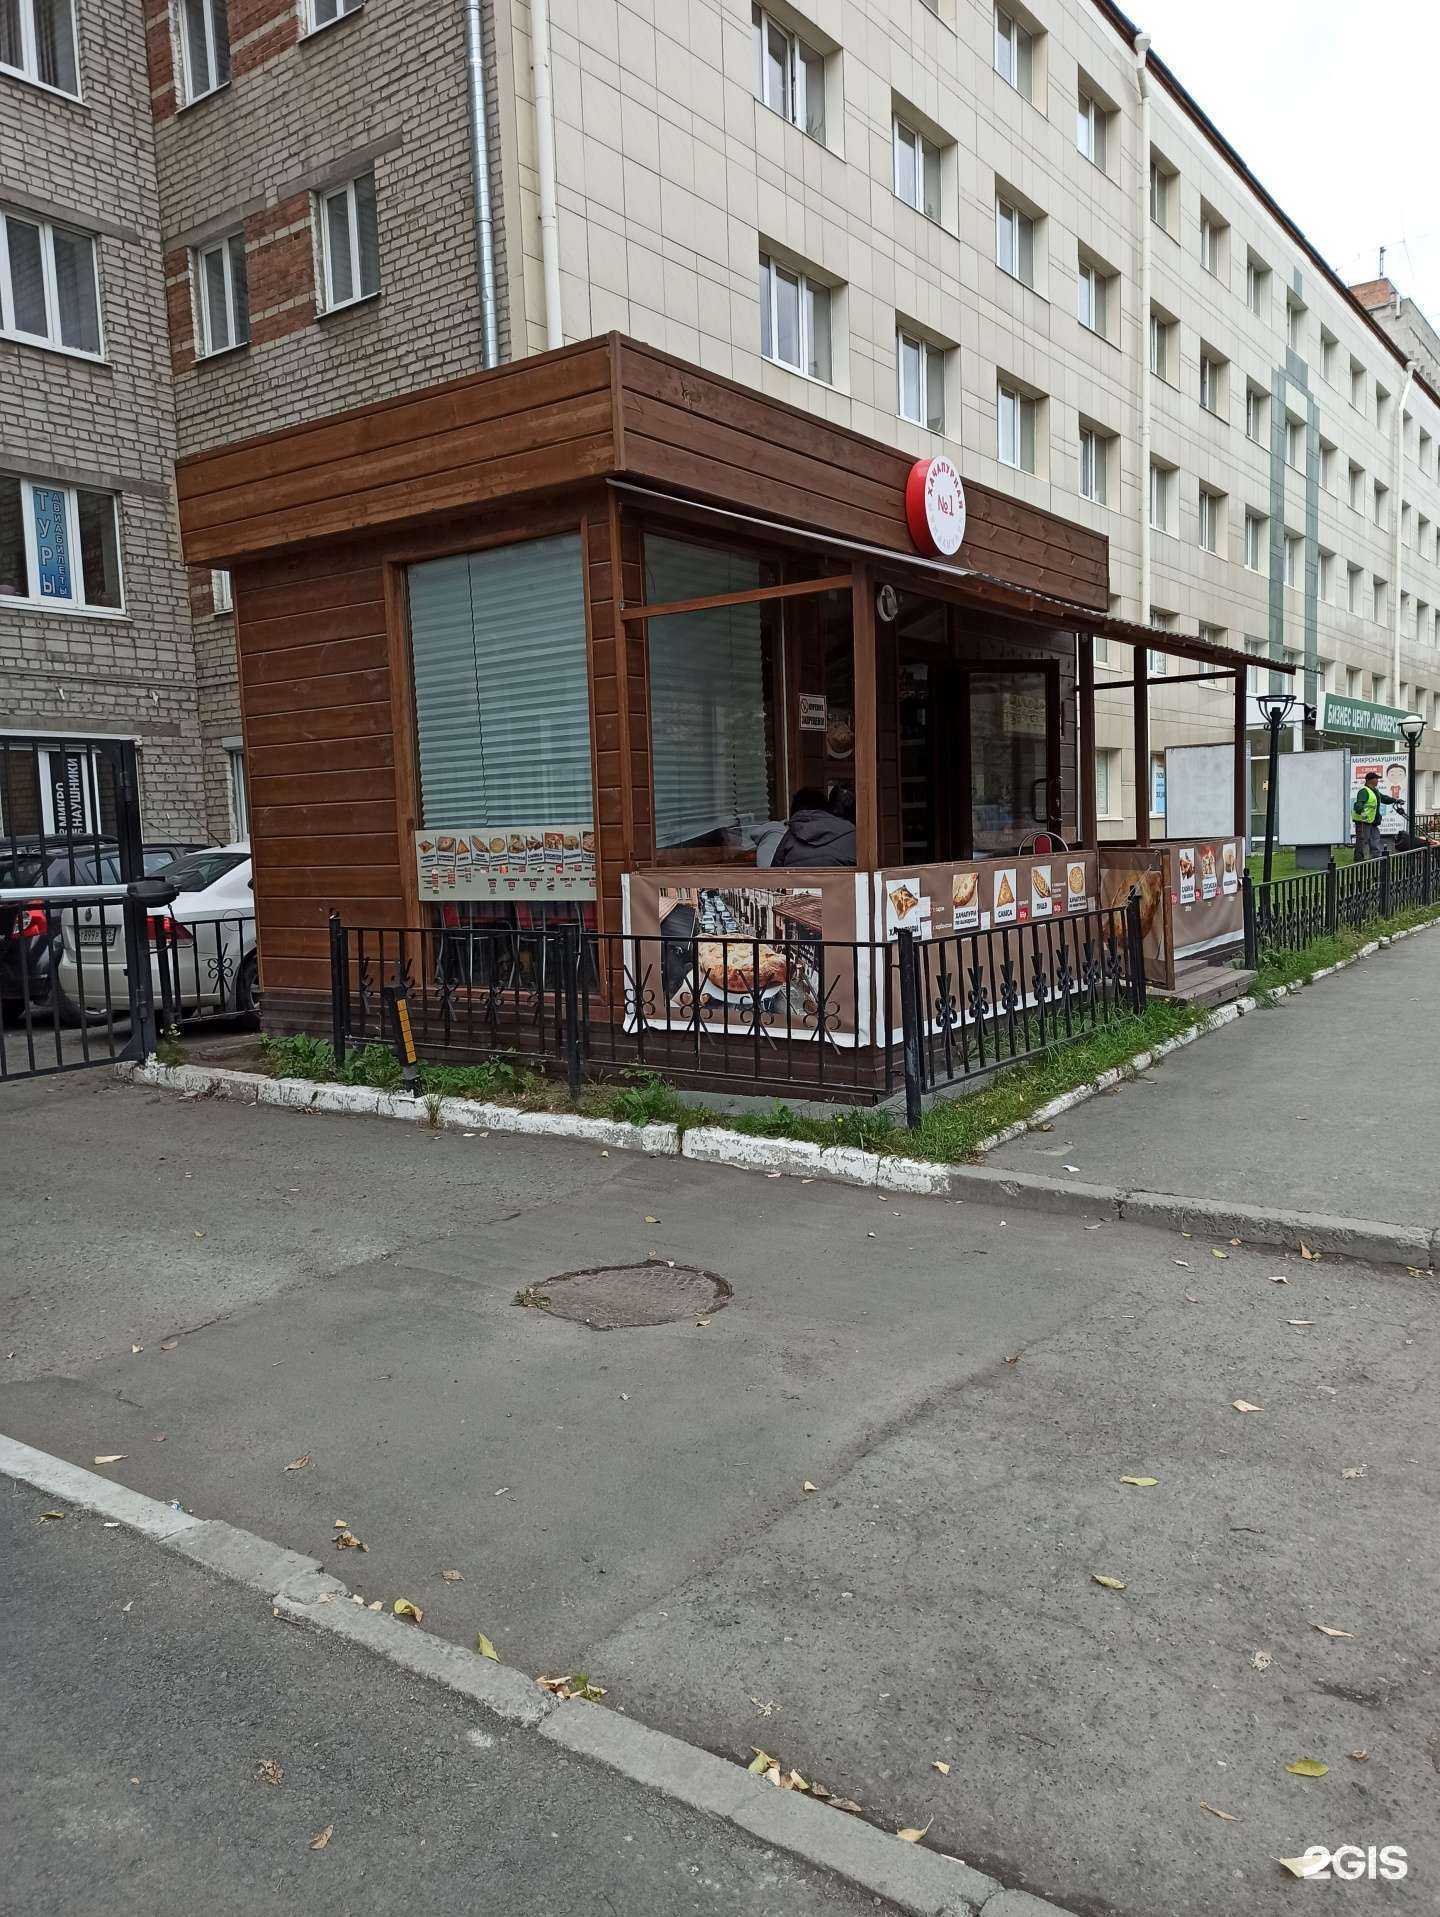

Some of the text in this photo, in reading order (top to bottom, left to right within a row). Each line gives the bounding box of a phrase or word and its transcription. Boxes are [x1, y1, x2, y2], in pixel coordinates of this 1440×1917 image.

[36, 490, 55, 594] ТУРЫ
[52, 493, 68, 595] АВИАБИЛЕТЫ
[1328, 704, 1352, 727] БИЗНЕС
[1352, 708, 1371, 731] ЦЕНТР
[67, 758, 83, 827] НАУШНИКИ
